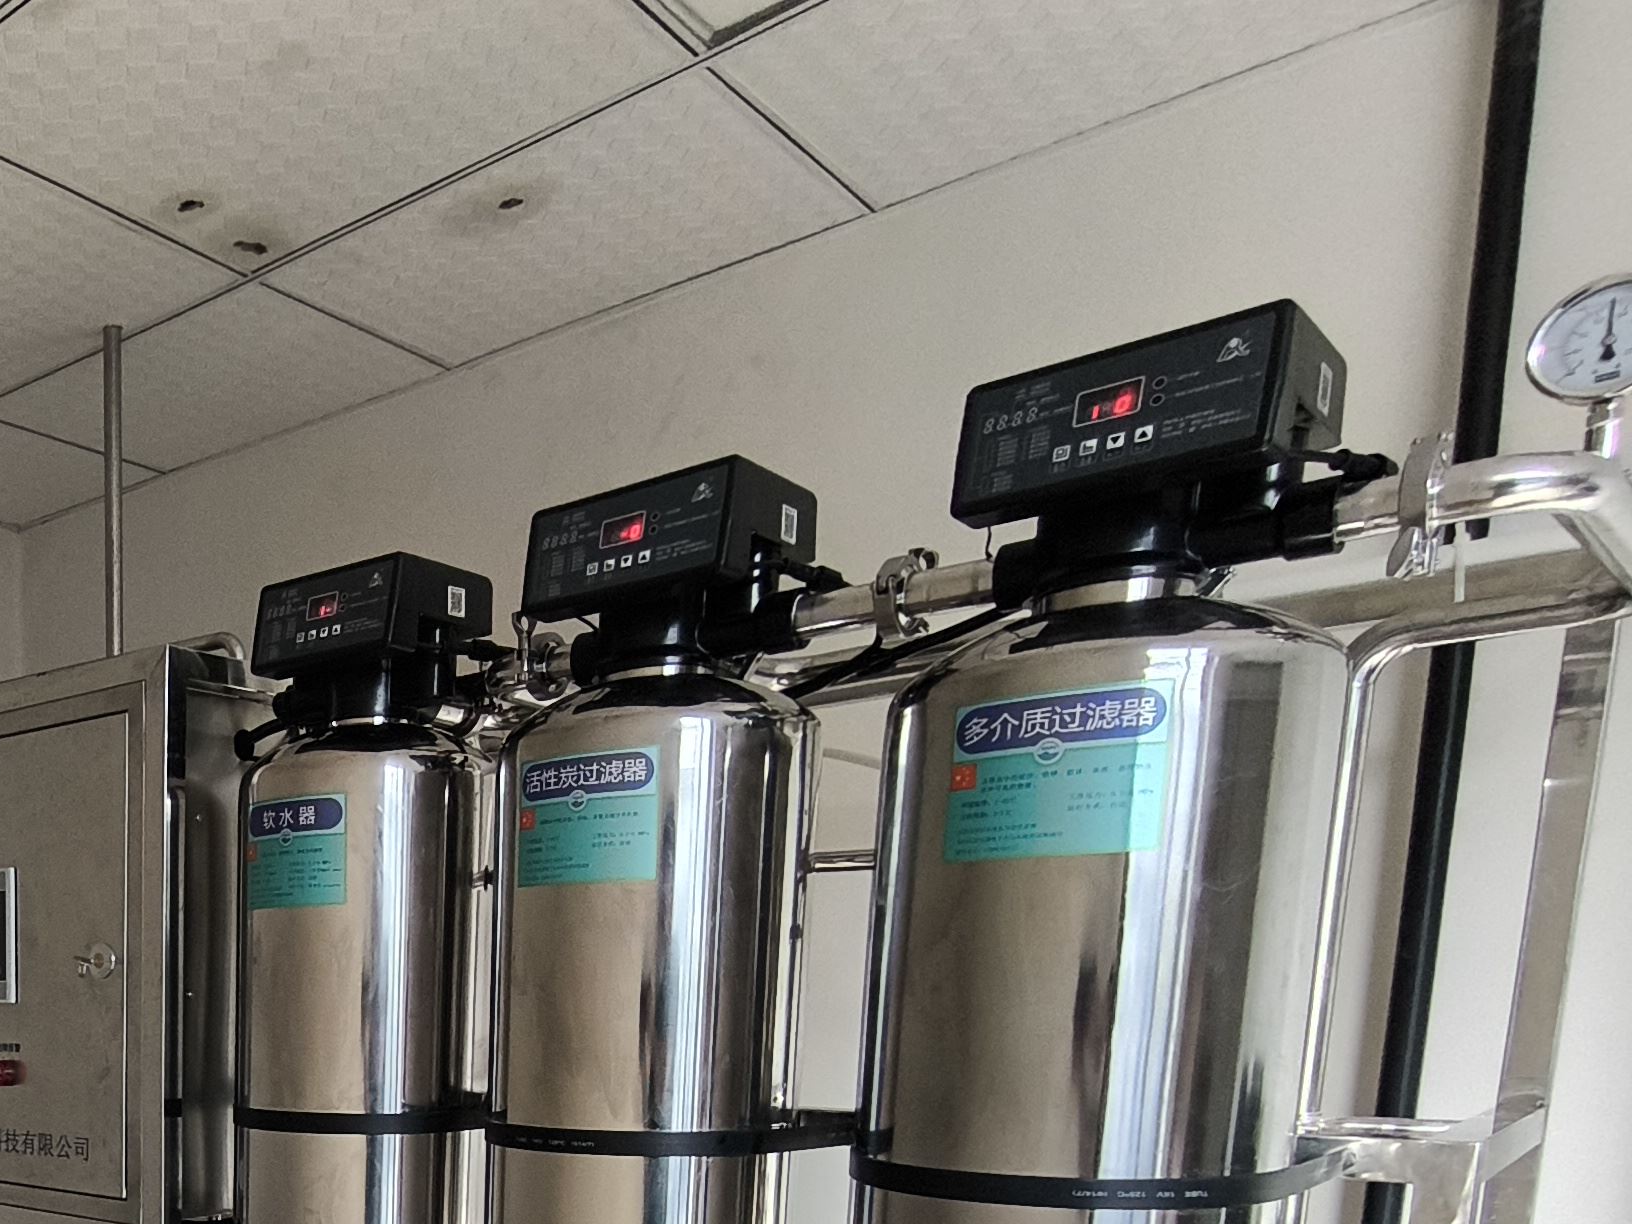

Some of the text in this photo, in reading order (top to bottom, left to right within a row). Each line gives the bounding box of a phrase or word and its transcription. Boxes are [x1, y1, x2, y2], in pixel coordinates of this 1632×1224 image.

[963, 697, 1158, 747] 多介质过滤器
[526, 758, 647, 794] 活性炭过滤器
[263, 805, 316, 830] 软水器
